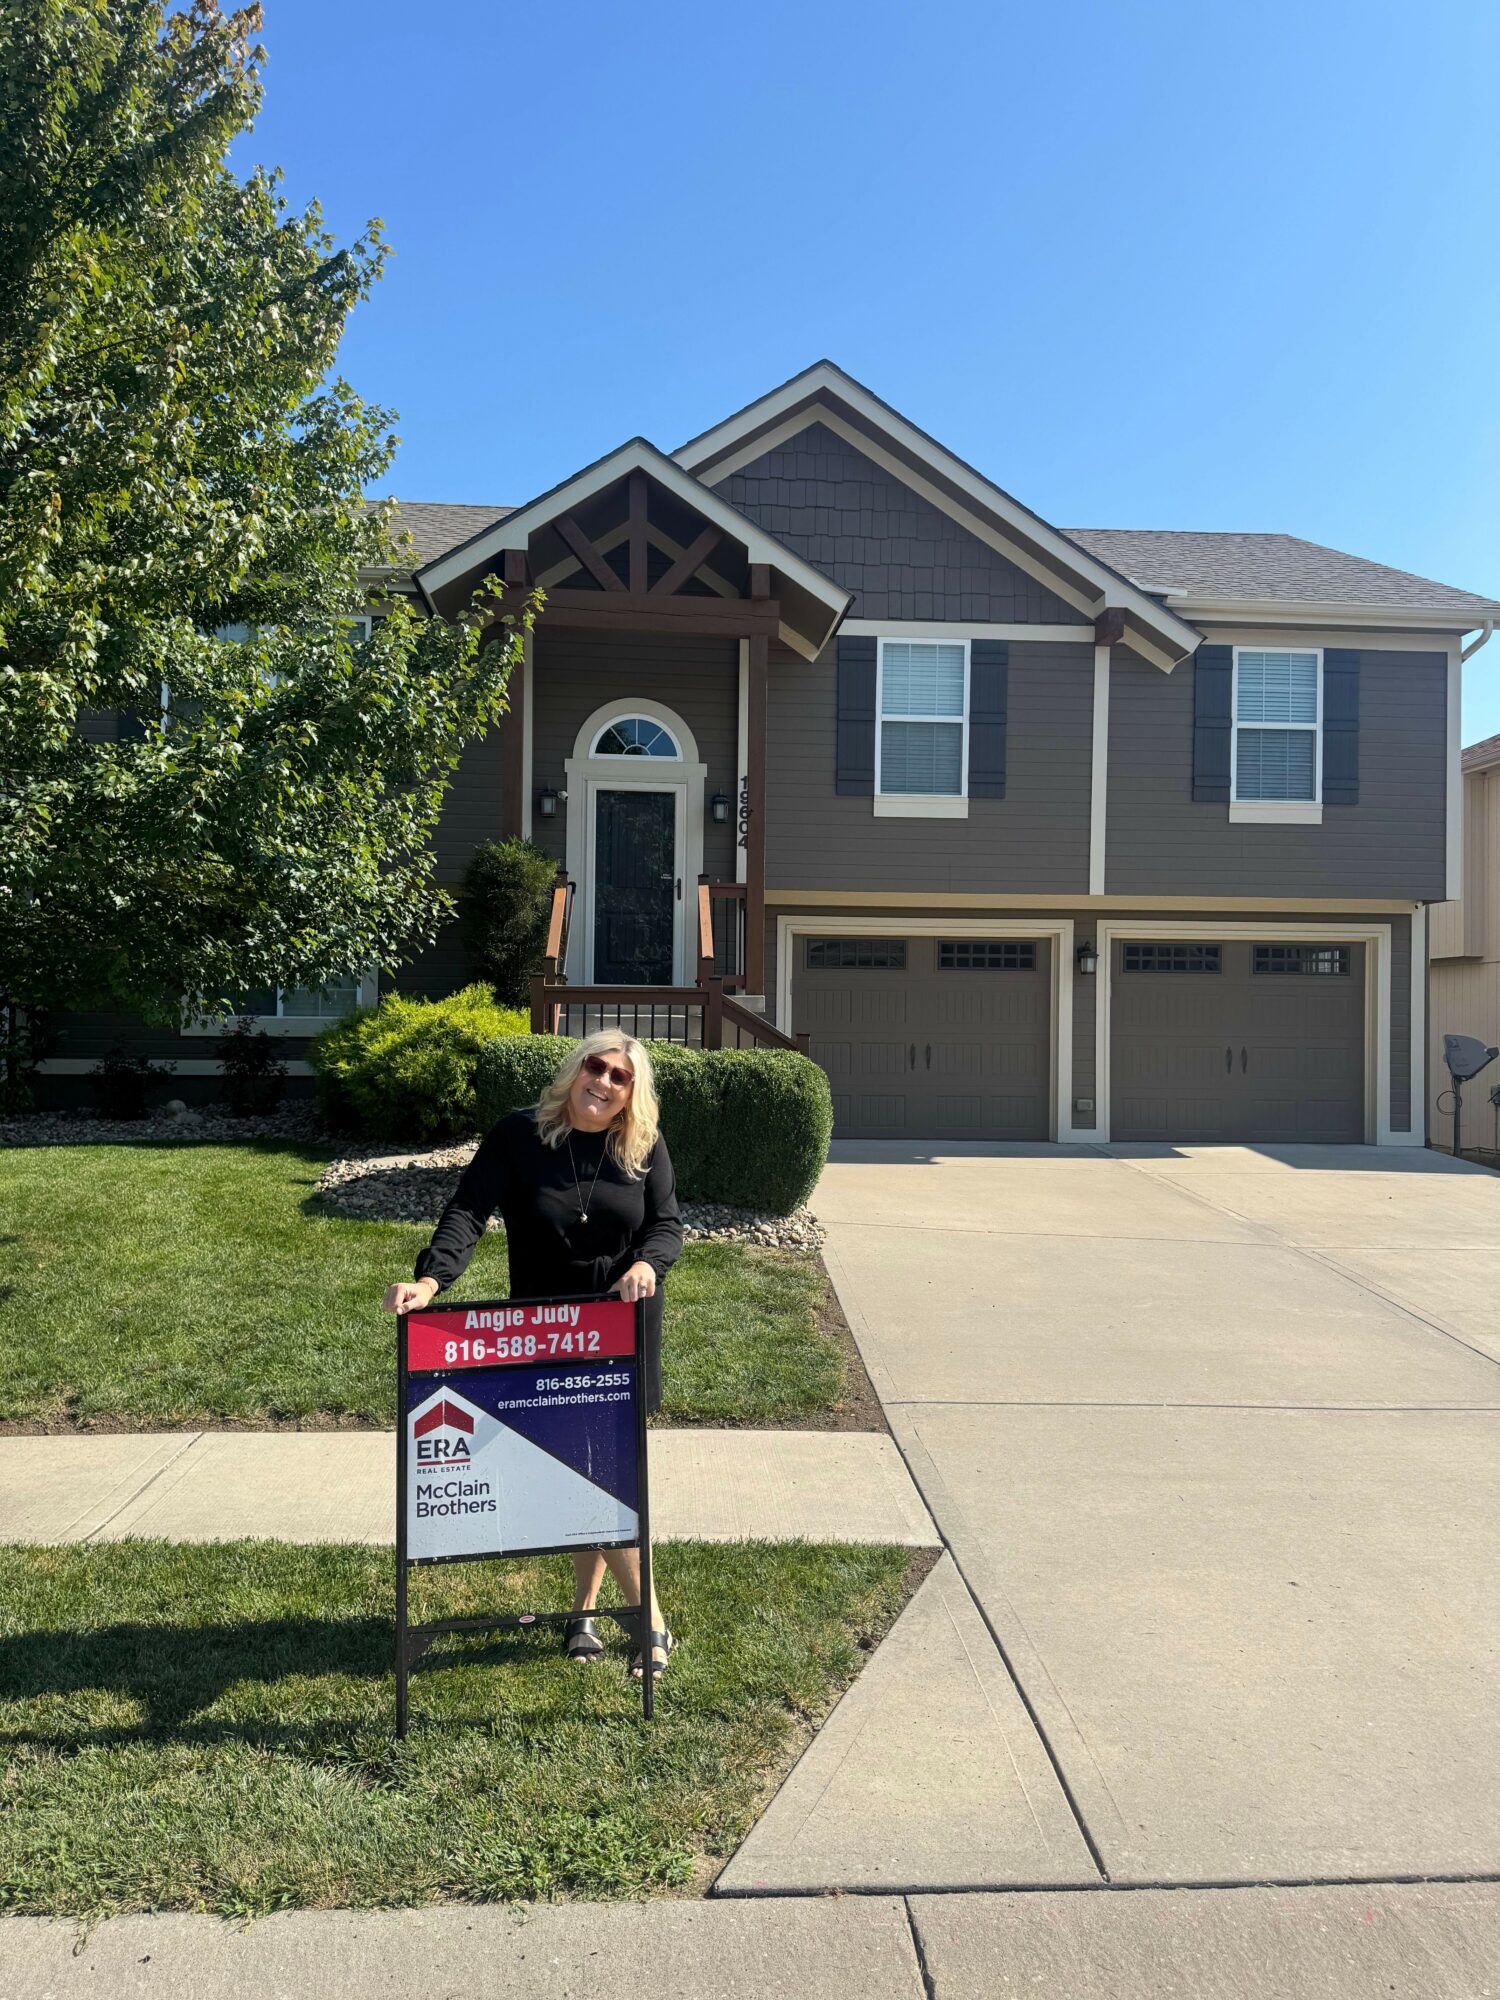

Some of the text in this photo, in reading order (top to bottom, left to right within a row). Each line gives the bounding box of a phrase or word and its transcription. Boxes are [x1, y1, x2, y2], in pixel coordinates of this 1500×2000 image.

[738, 775, 748, 849] 19604
[465, 1304, 581, 1332] Angie Judy
[444, 1330, 600, 1363] 816-588-7412
[536, 1373, 630, 1391] 816-836-2555
[498, 1391, 631, 1410] eramcclainbrothers.com
[417, 1437, 471, 1459] ERA
[416, 1464, 471, 1475] REAL ESTATE
[416, 1479, 490, 1500] McClain
[416, 1498, 497, 1518] Brothers
